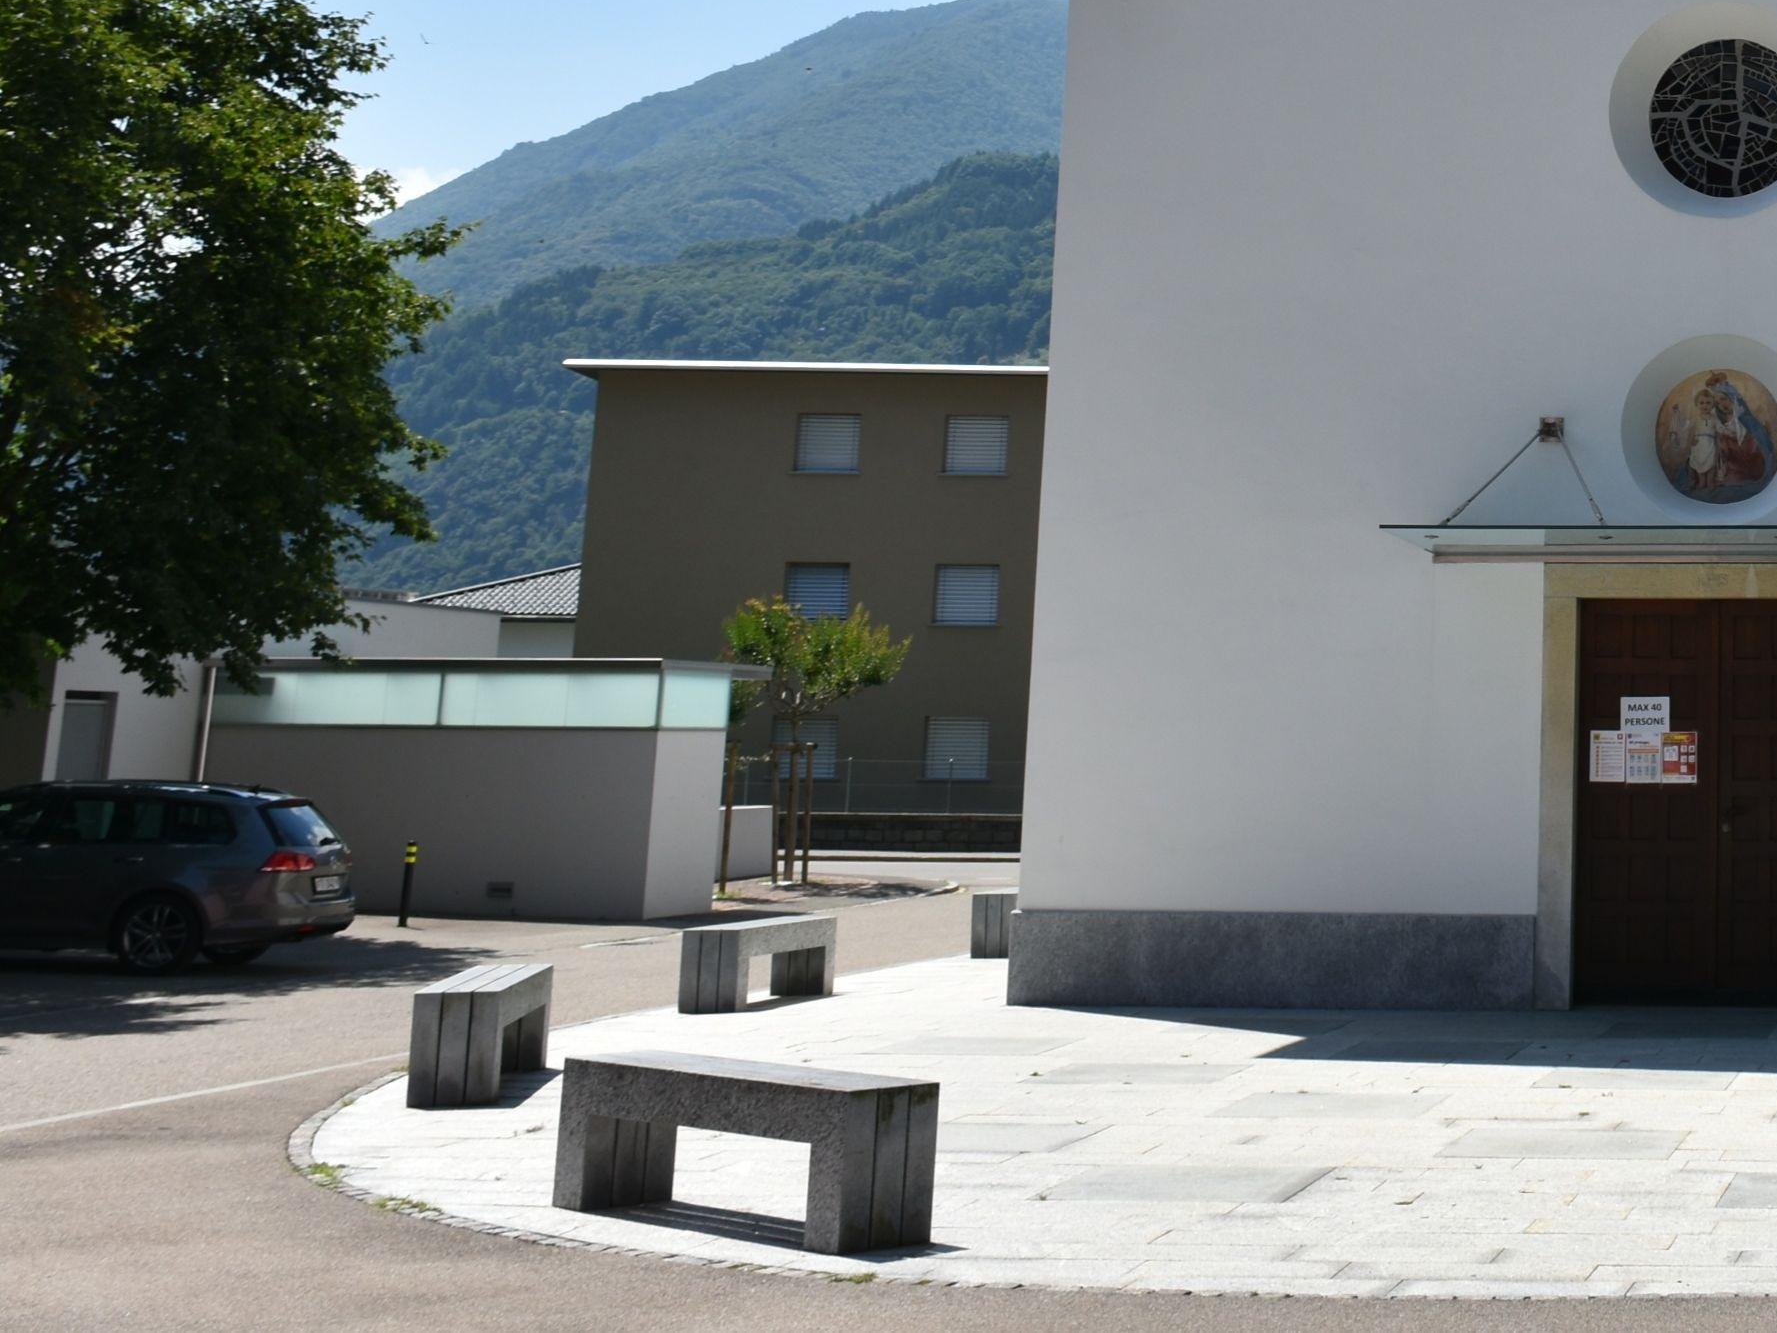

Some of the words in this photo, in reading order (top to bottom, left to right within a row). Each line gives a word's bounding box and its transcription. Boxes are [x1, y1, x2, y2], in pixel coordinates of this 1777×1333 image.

[1628, 703, 1649, 712] MAX
[1651, 703, 1662, 712] 40
[1625, 717, 1665, 726] PERSONE
